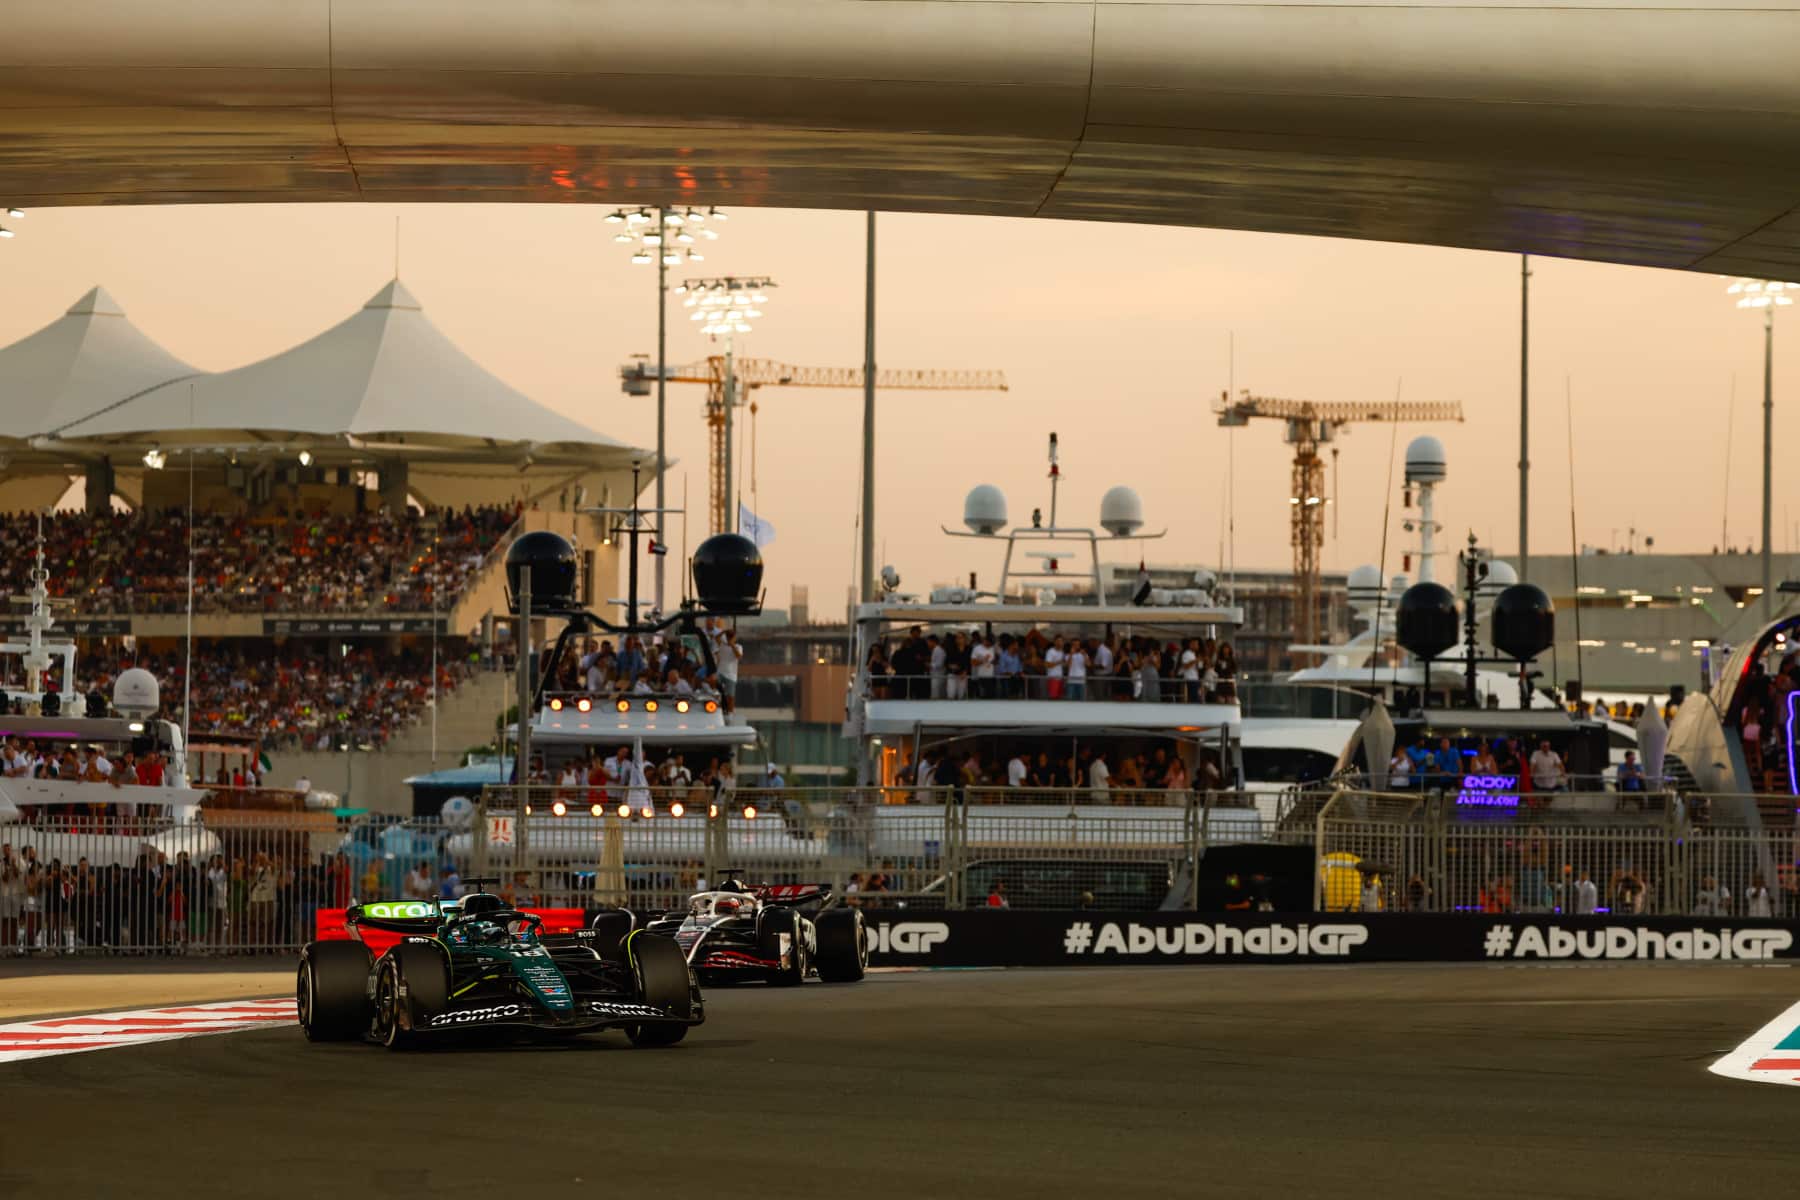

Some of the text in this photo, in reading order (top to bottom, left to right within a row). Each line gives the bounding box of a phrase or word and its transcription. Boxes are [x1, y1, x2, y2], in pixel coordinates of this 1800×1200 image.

[1063, 922, 1369, 955] #AbuDhabiGP
[1484, 925, 1793, 960] #AbuDhabiGP
[431, 1004, 520, 1026] aramco
[591, 1001, 665, 1017] aramco
